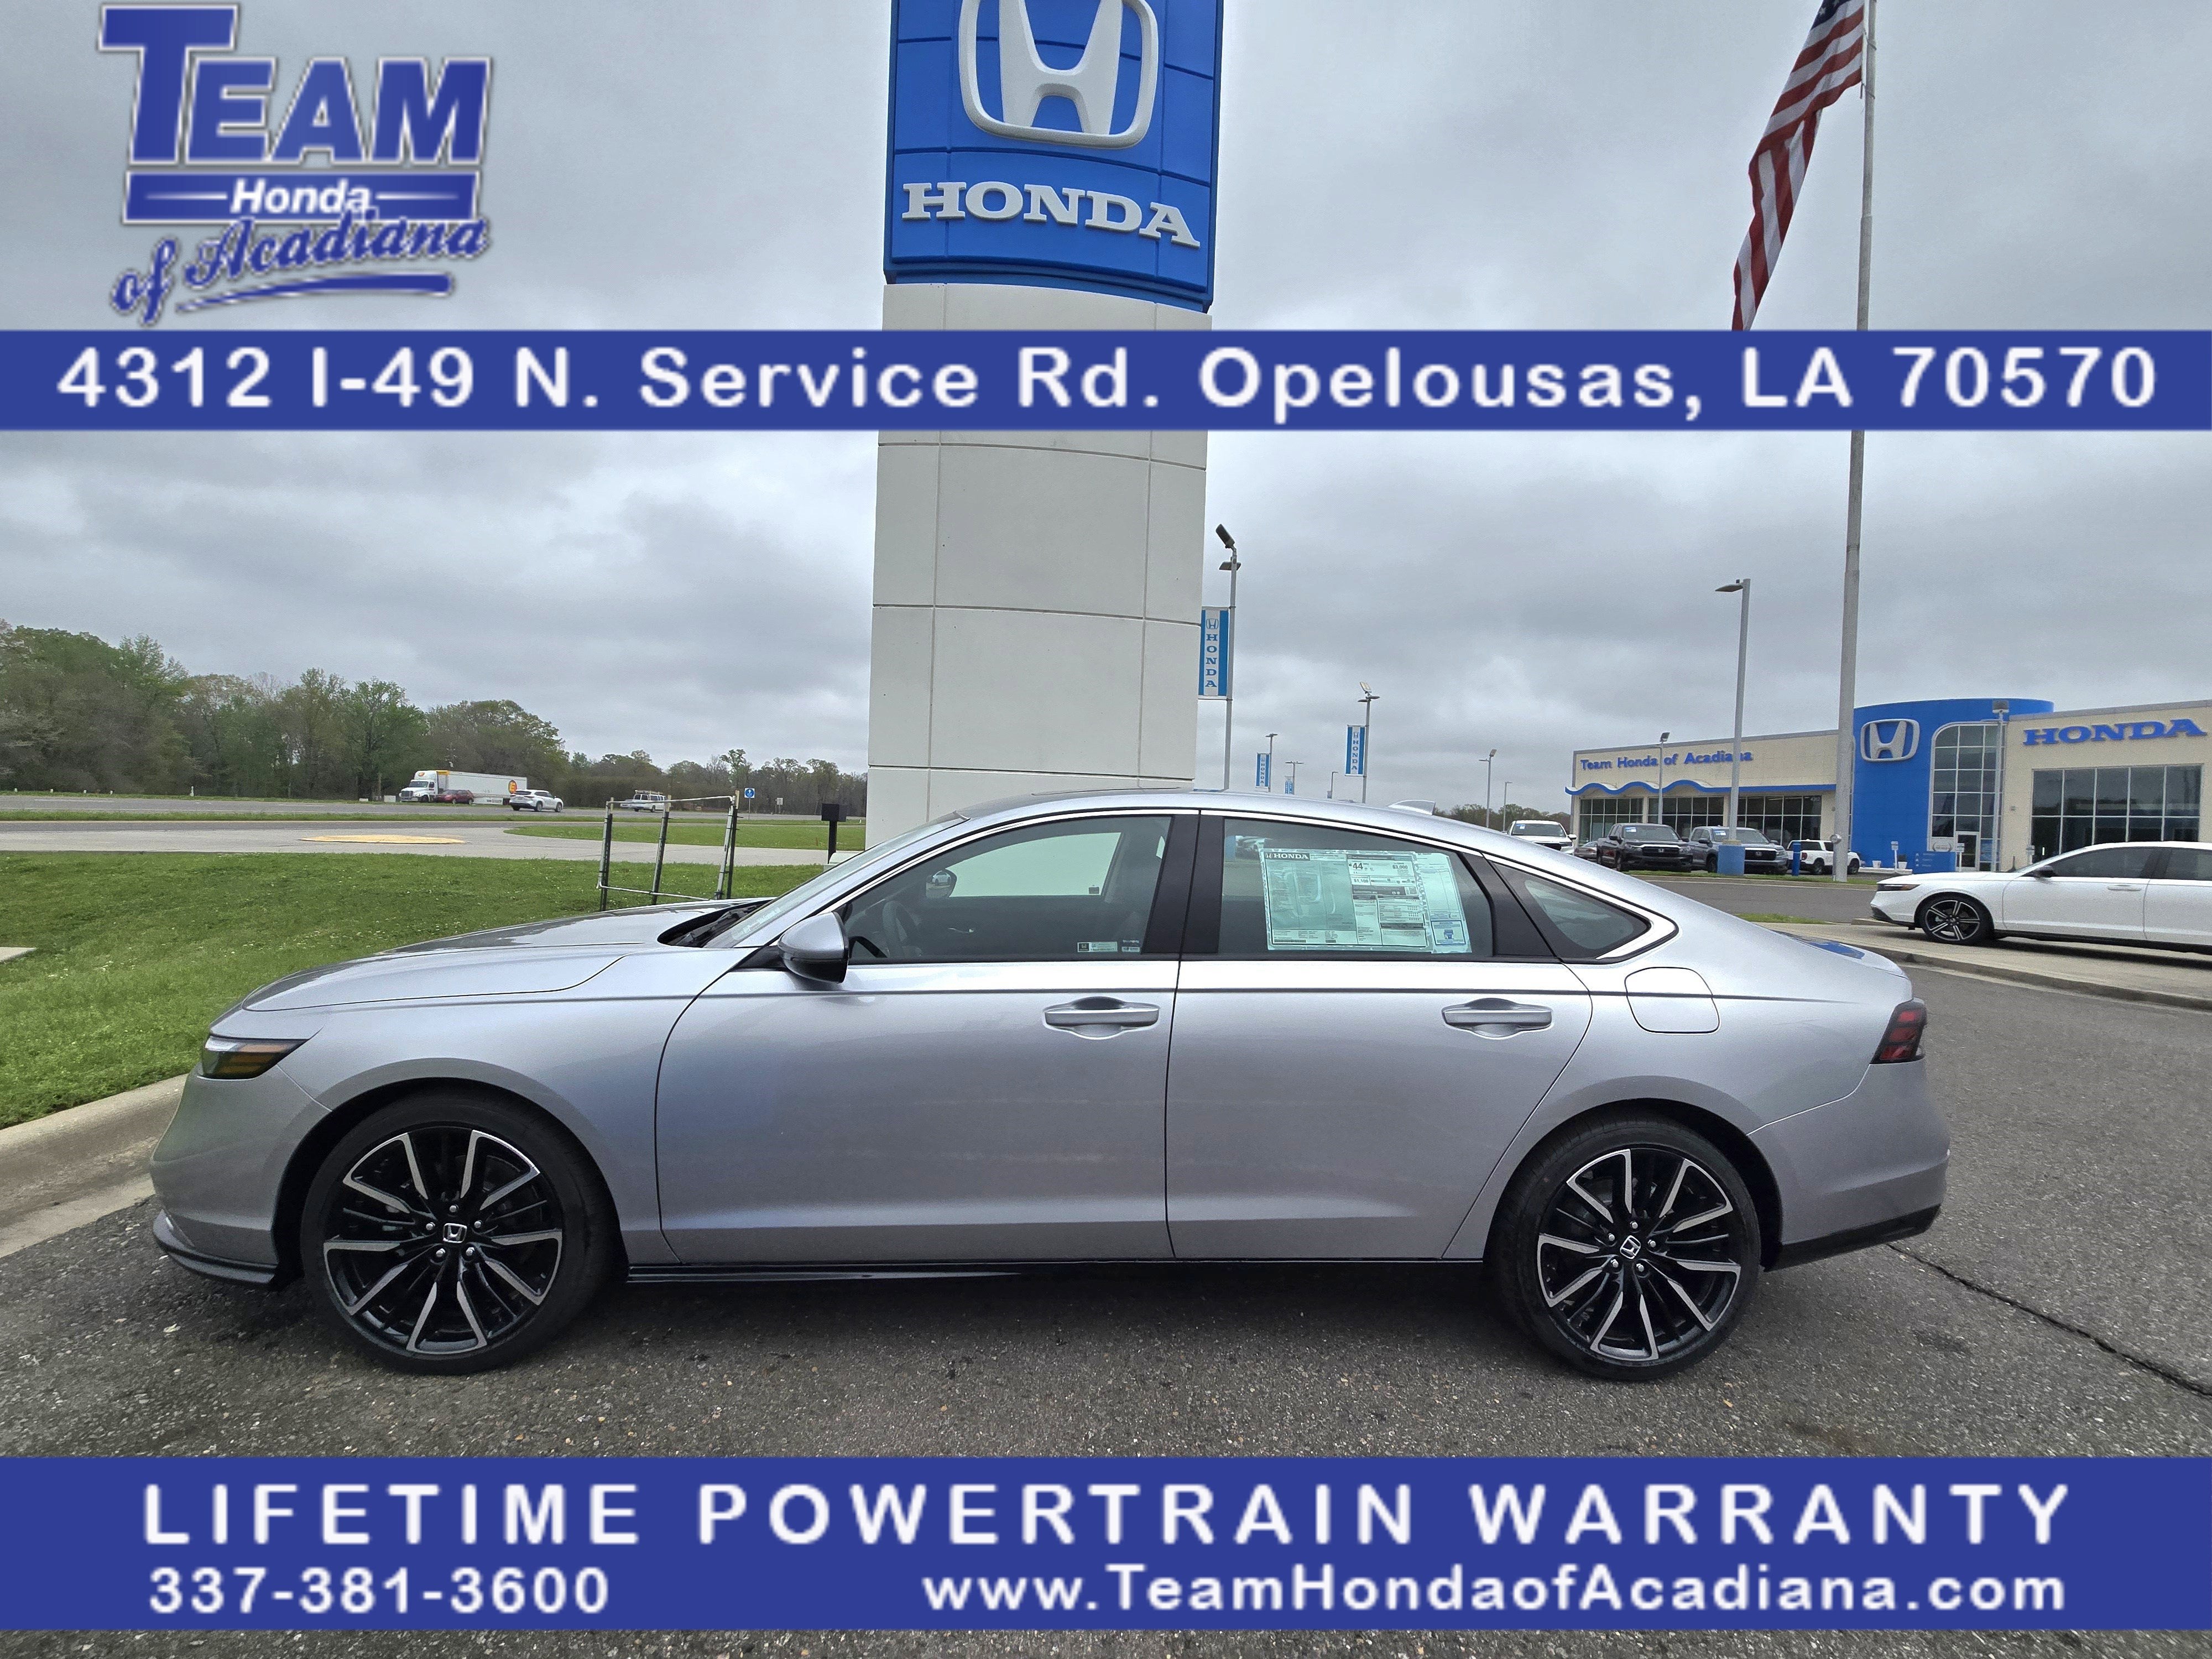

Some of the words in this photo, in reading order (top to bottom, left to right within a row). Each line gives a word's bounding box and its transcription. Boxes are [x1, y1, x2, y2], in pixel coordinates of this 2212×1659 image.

[902, 181, 1201, 248] HONDA
[1205, 634, 1218, 687] HONDA
[2023, 718, 2208, 745] HONDA
[1580, 759, 1612, 770] Team
[1618, 755, 1658, 768] Honda
[1664, 753, 1678, 765] of
